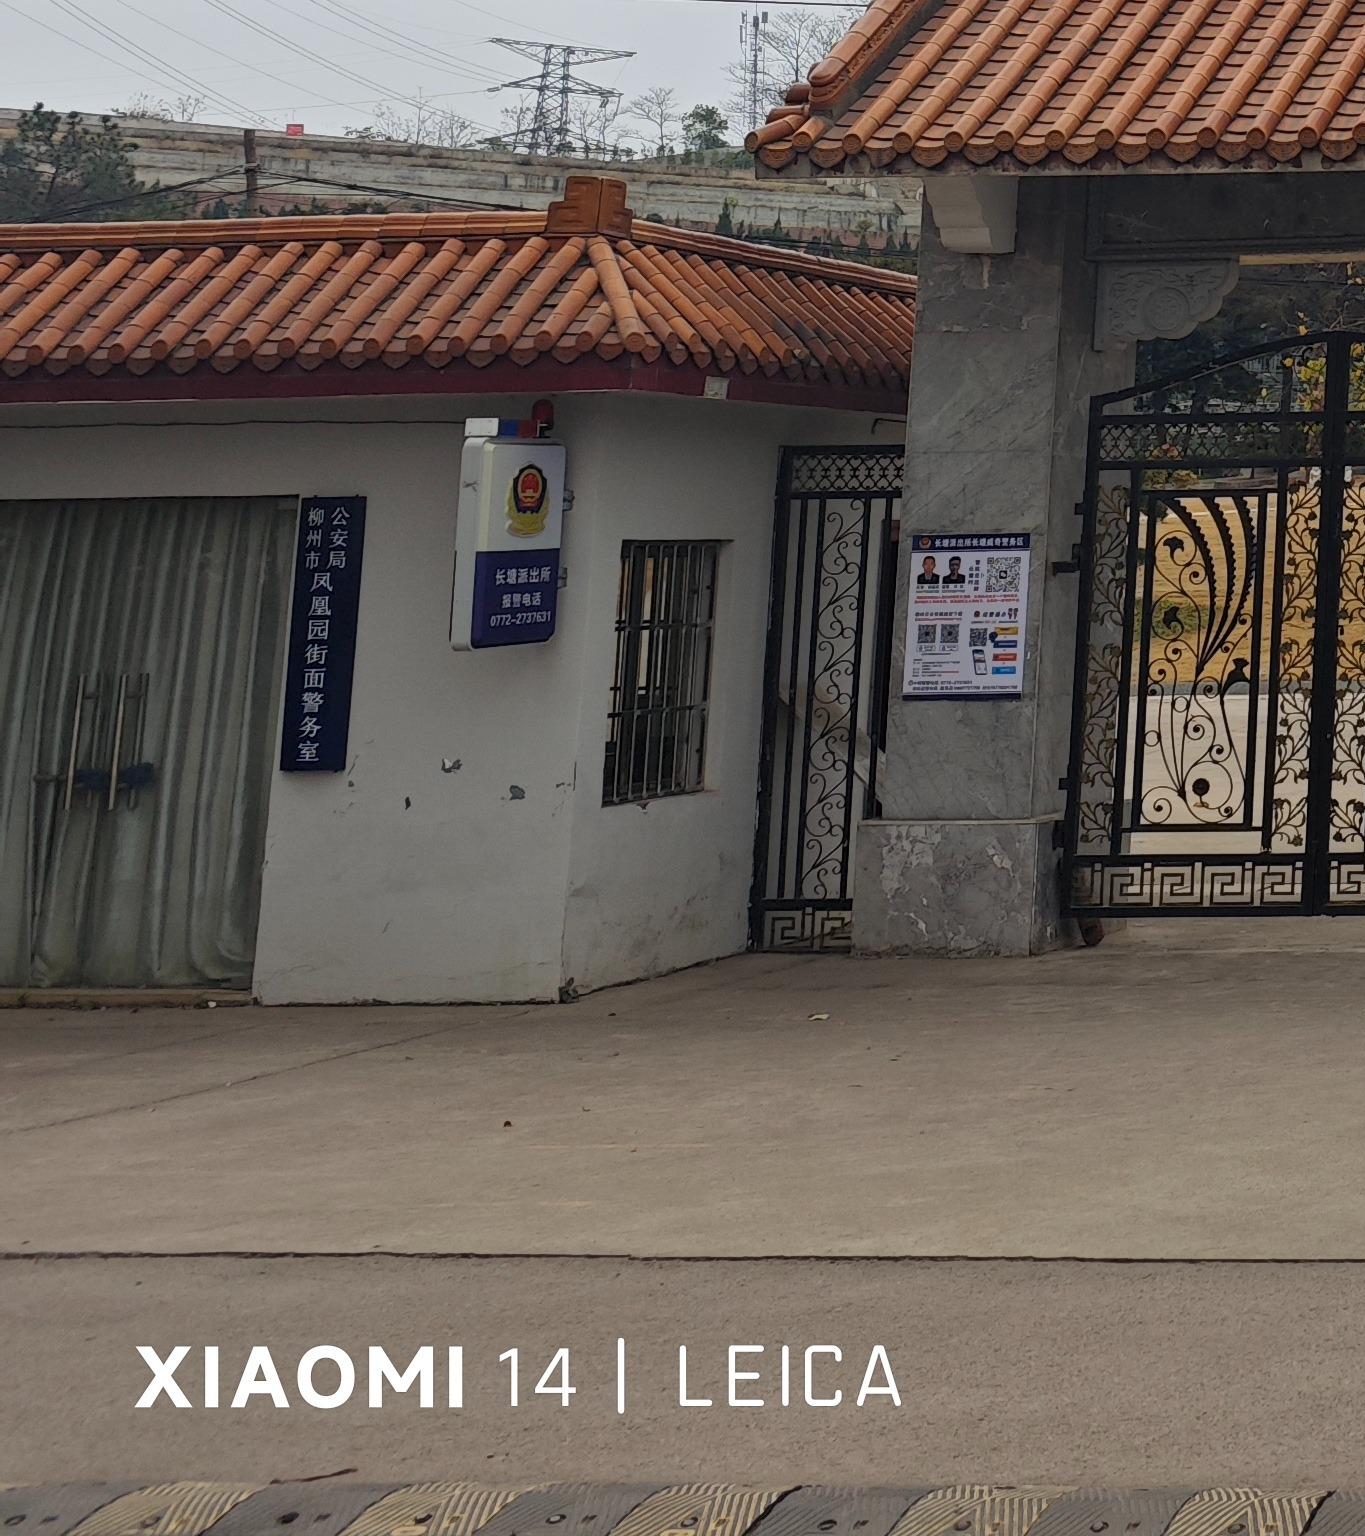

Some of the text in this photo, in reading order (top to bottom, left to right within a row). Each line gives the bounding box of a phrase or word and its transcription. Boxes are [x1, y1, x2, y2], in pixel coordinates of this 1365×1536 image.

[304, 506, 326, 569] 柳州市
[325, 506, 351, 570] 公安局
[495, 566, 552, 586] 长塘派出所
[490, 610, 552, 627] 0772-2737631
[501, 592, 542, 609] 报警电话
[295, 571, 334, 763] 凤凰园街面警务室
